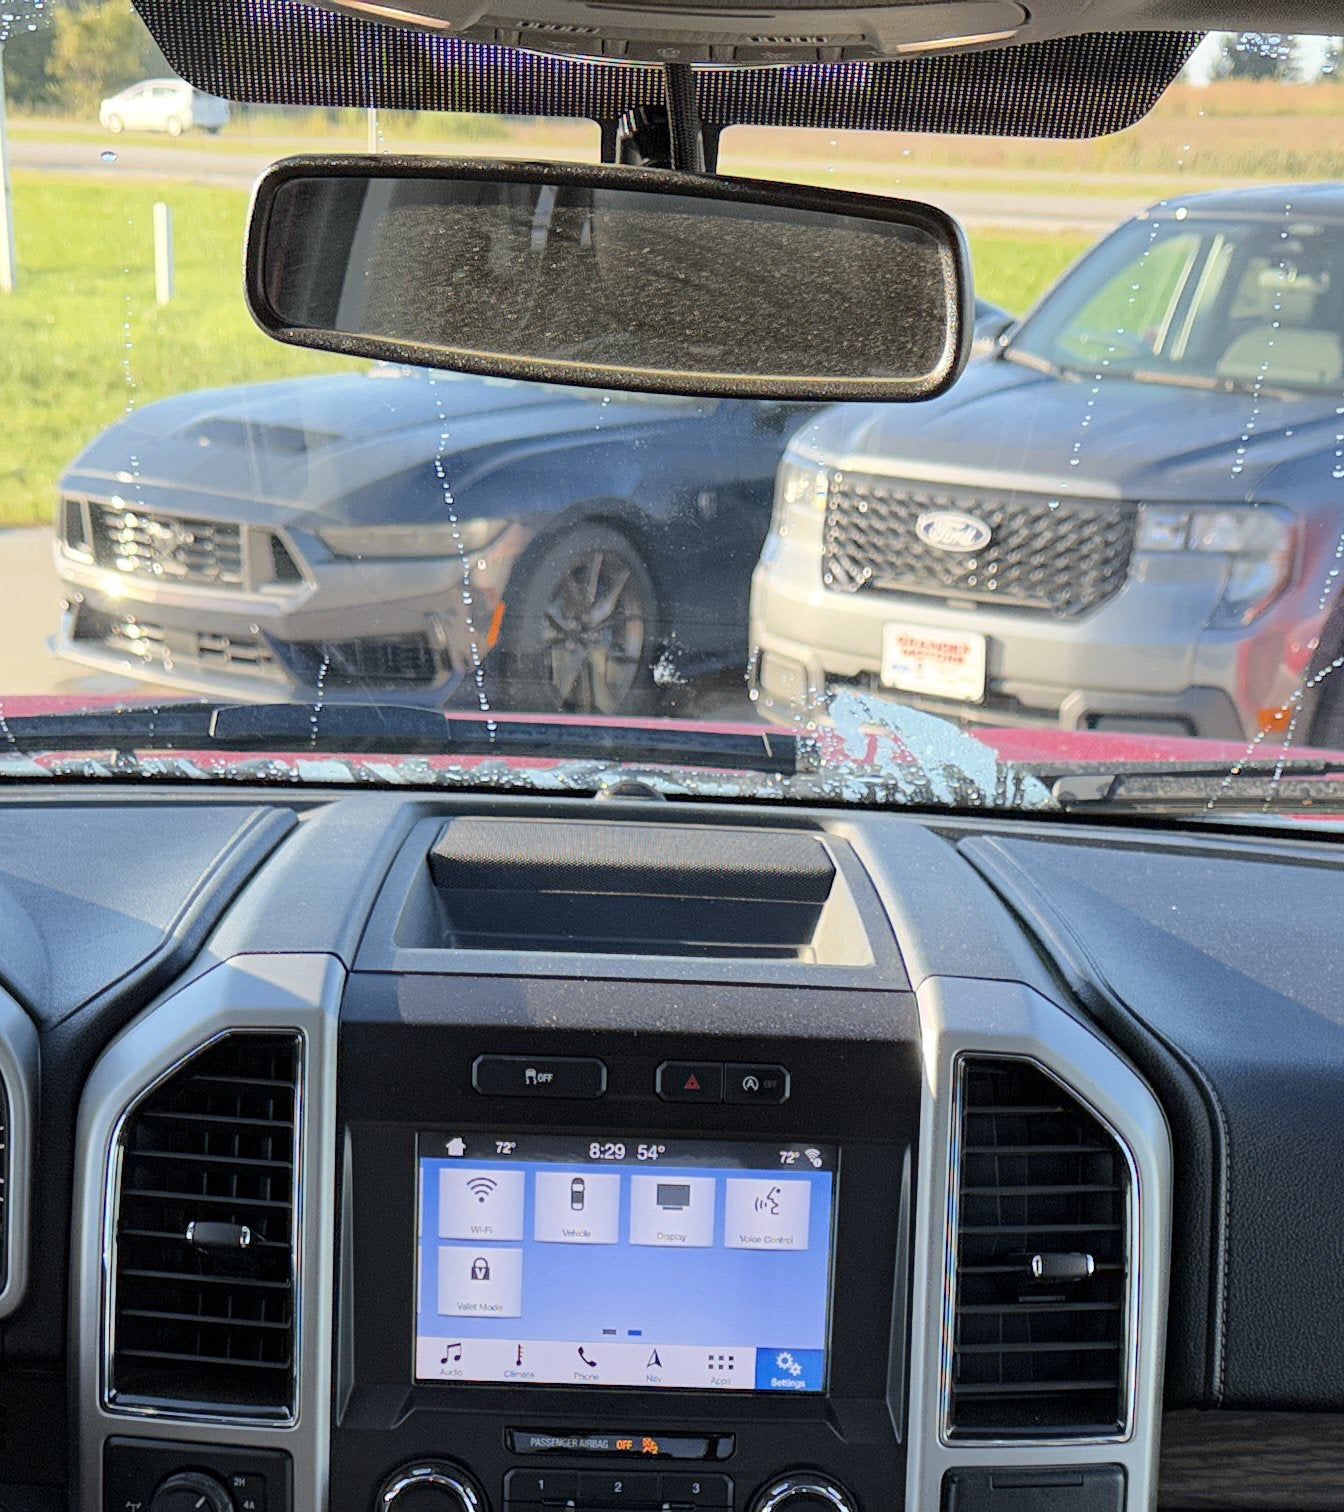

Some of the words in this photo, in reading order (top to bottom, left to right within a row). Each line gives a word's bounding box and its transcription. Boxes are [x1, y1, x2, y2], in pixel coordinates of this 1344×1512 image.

[537, 1073, 553, 1083] OFF
[589, 1143, 626, 1159] 8:29
[637, 1144, 666, 1160] 54°
[562, 1228, 591, 1238] Vehicle
[657, 1232, 687, 1242] Display
[739, 1234, 762, 1244] Voice
[763, 1236, 794, 1245] Control
[456, 1302, 477, 1311] Valet
[479, 1303, 504, 1312] Mode
[439, 1368, 463, 1377] Audio
[504, 1370, 535, 1379] Climate
[573, 1372, 599, 1381] Phone
[646, 1374, 662, 1383] Nav
[710, 1376, 732, 1386] Apps
[770, 1377, 806, 1389] Settings
[530, 1437, 578, 1448] PASSENGER
[578, 1438, 609, 1449] AIRBAG
[616, 1440, 633, 1450] OFF
[233, 1478, 246, 1487] 2H
[538, 1479, 544, 1489] 1
[614, 1482, 622, 1493] 2
[692, 1483, 700, 1494] 3
[243, 1500, 255, 1510] 4A
